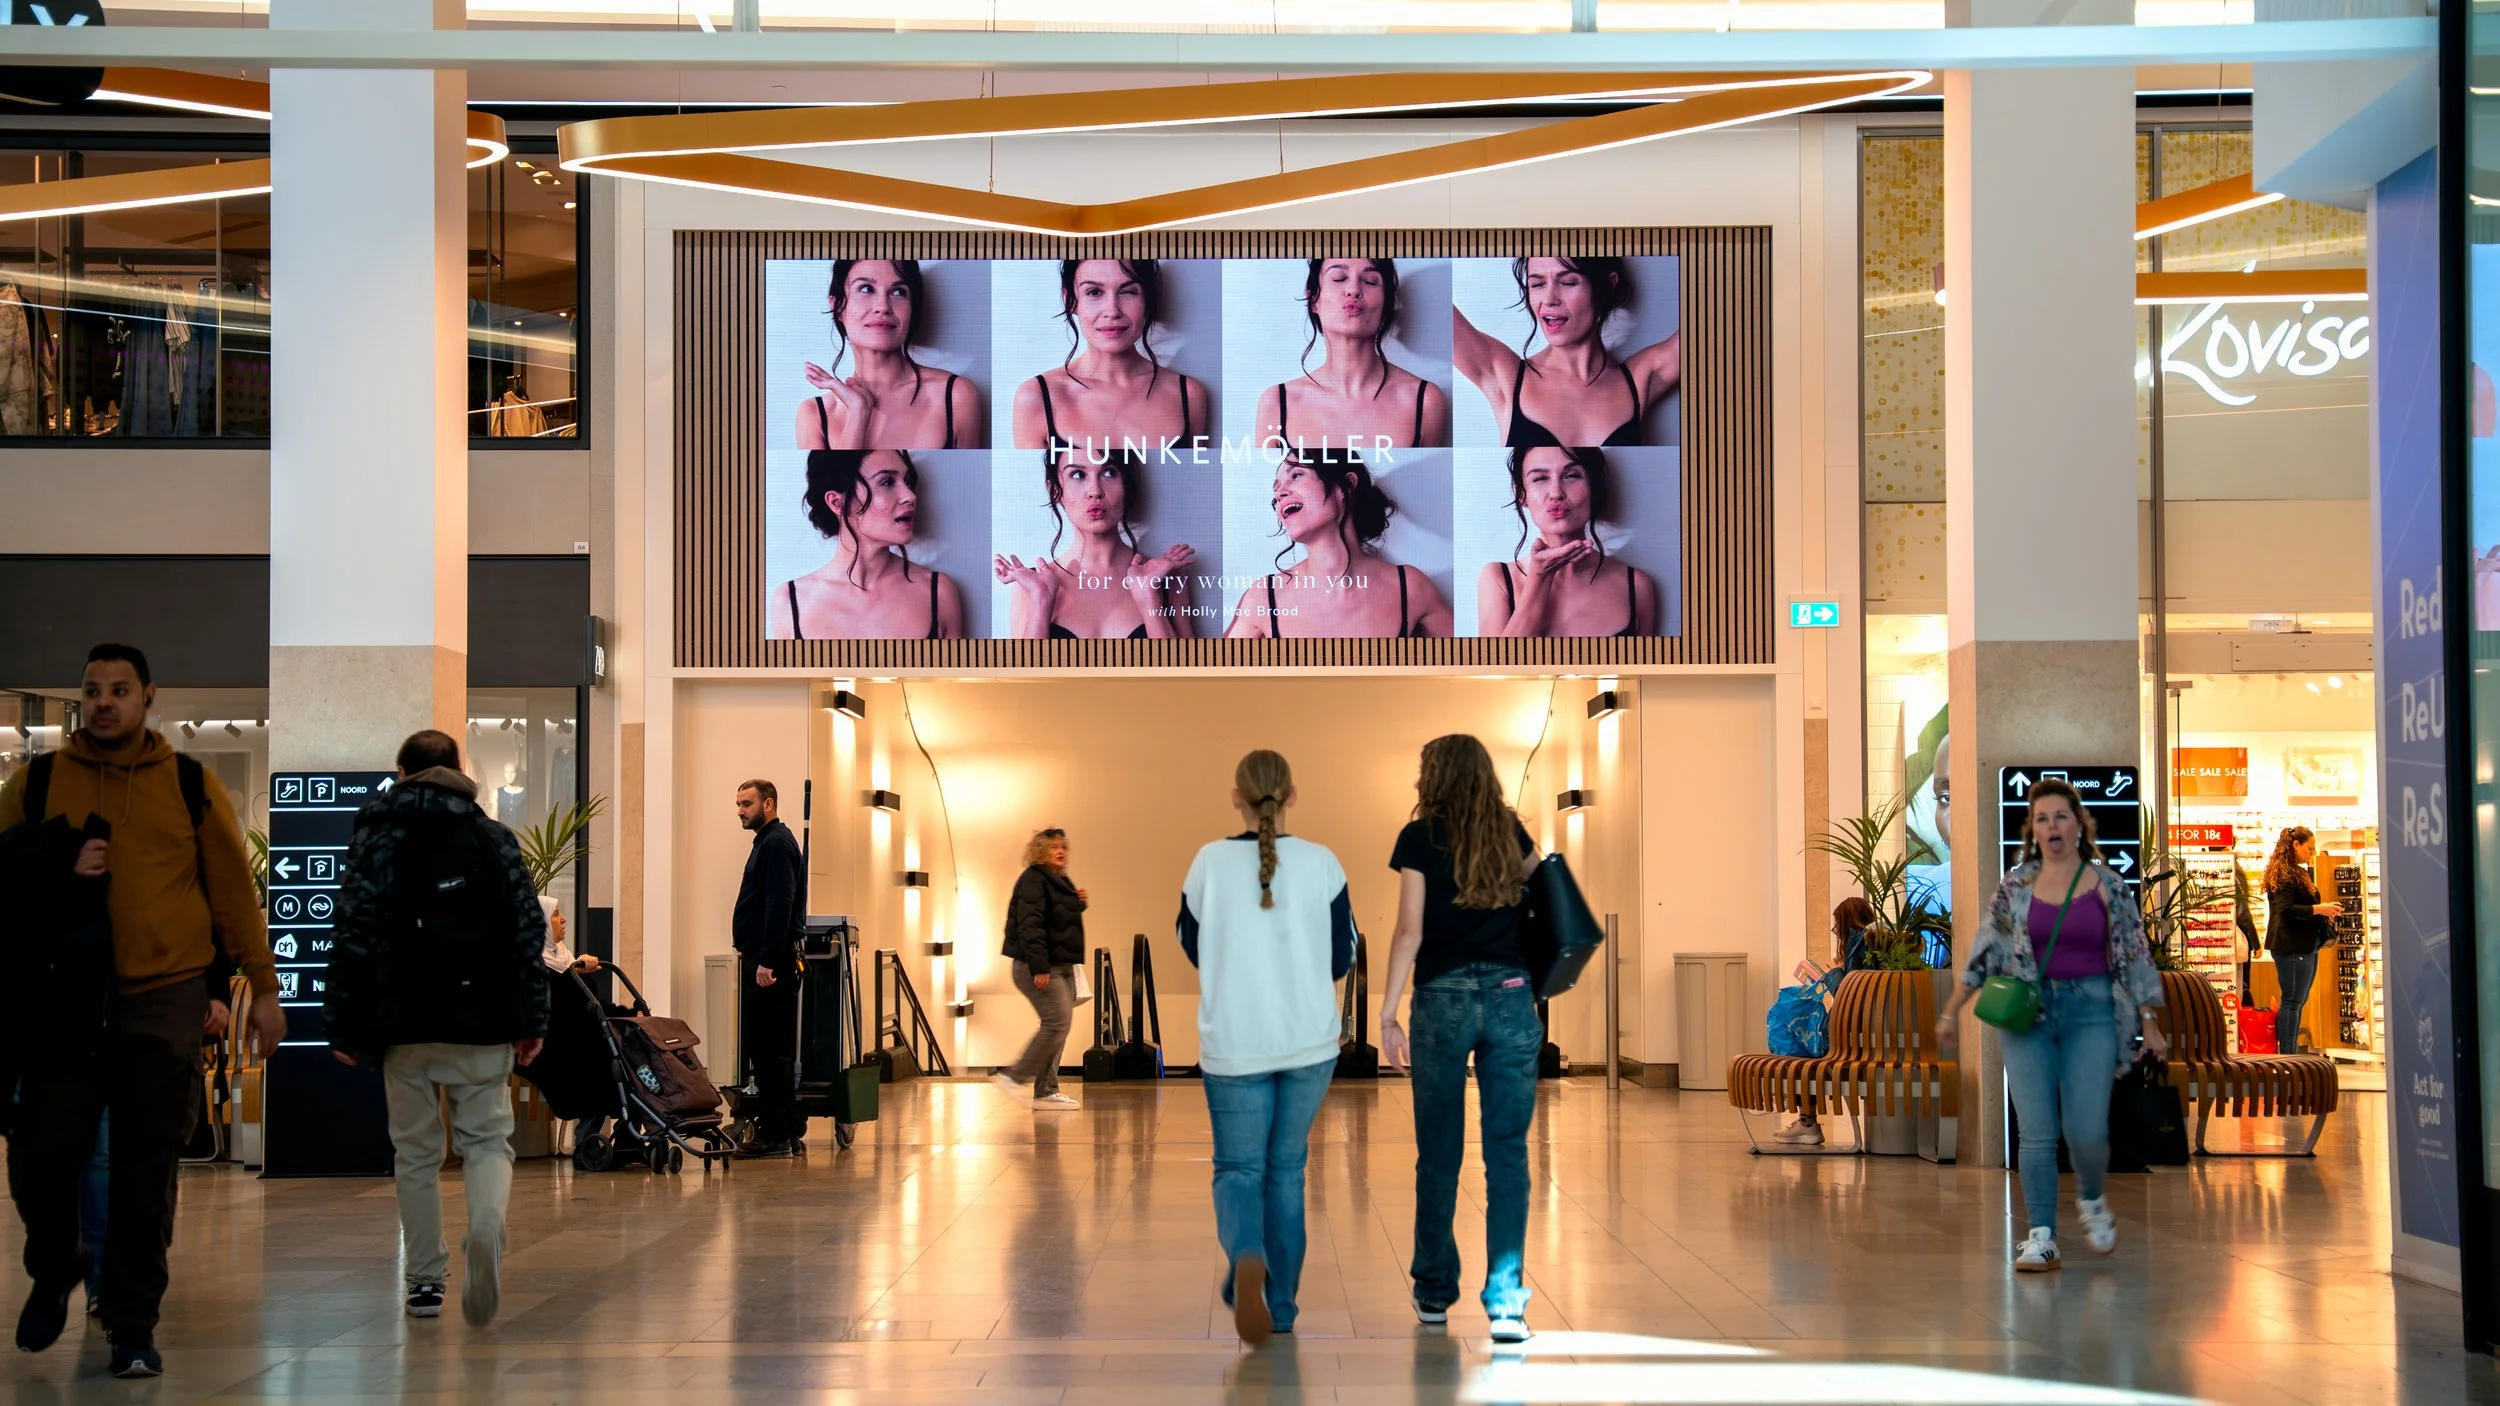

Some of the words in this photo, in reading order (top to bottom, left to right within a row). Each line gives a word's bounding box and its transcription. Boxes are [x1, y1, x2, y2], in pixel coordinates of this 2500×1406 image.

[1050, 425, 1396, 465] HUNKEMÖLLER
[1077, 569, 1113, 590] for
[1121, 575, 1189, 594] every
[1198, 575, 1285, 590] woman
[1294, 571, 1316, 589] in
[1325, 575, 1369, 594] you
[1148, 606, 1177, 617] with
[1181, 606, 1218, 619] Holly
[1223, 606, 1251, 617] Mae
[1257, 606, 1299, 617] Brood
[2402, 675, 2445, 743] ReU
[2073, 780, 2101, 788] NOORD
[2173, 768, 2196, 777] SALE
[2199, 767, 2221, 777] SALE
[2224, 768, 2247, 777] SALE
[340, 786, 368, 794] NOORD
[2403, 783, 2448, 848] ReS
[2176, 829, 2200, 841] FOR
[2204, 829, 2221, 841] 18€
[2413, 1072, 2429, 1096] Act
[2430, 1074, 2444, 1099] for
[2419, 1103, 2441, 1128] good
